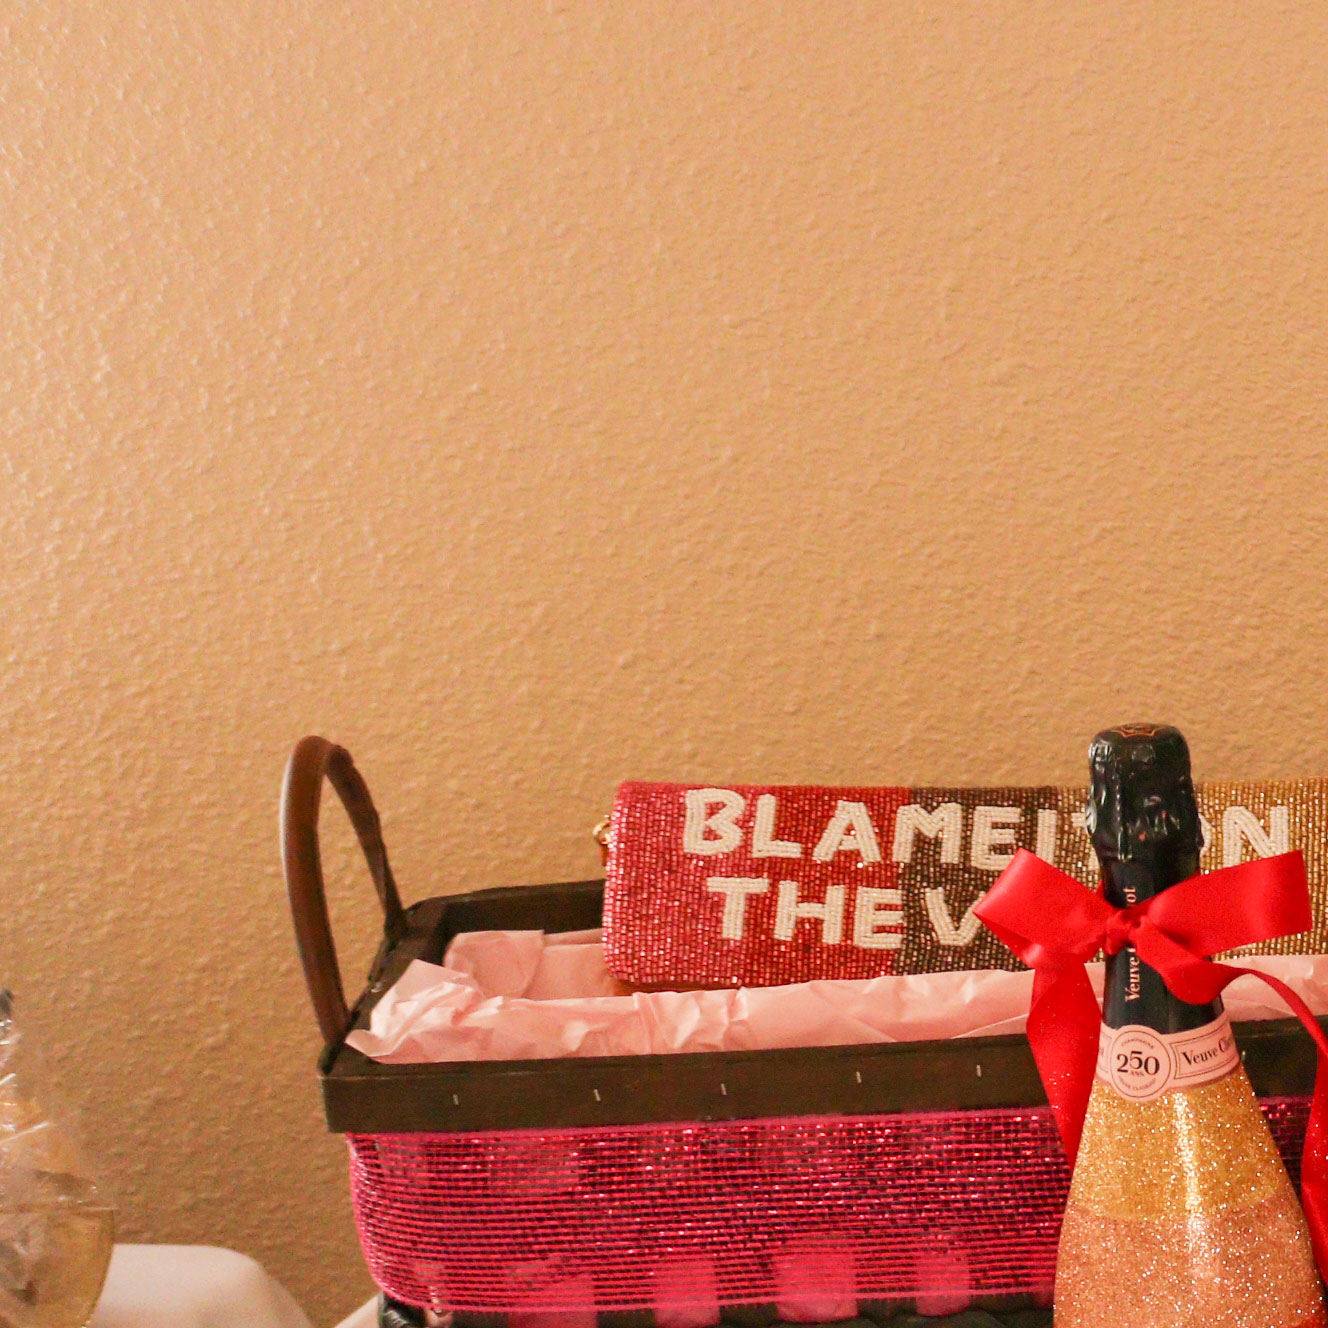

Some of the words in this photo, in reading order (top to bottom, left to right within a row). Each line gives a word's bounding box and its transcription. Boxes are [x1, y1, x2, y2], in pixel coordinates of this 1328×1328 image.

[682, 788, 1019, 871] BLAME
[707, 876, 903, 951] THE
[1124, 956, 1141, 1003] Veuve
[1116, 1050, 1160, 1075] 250
[1181, 1045, 1219, 1066] Veuve
